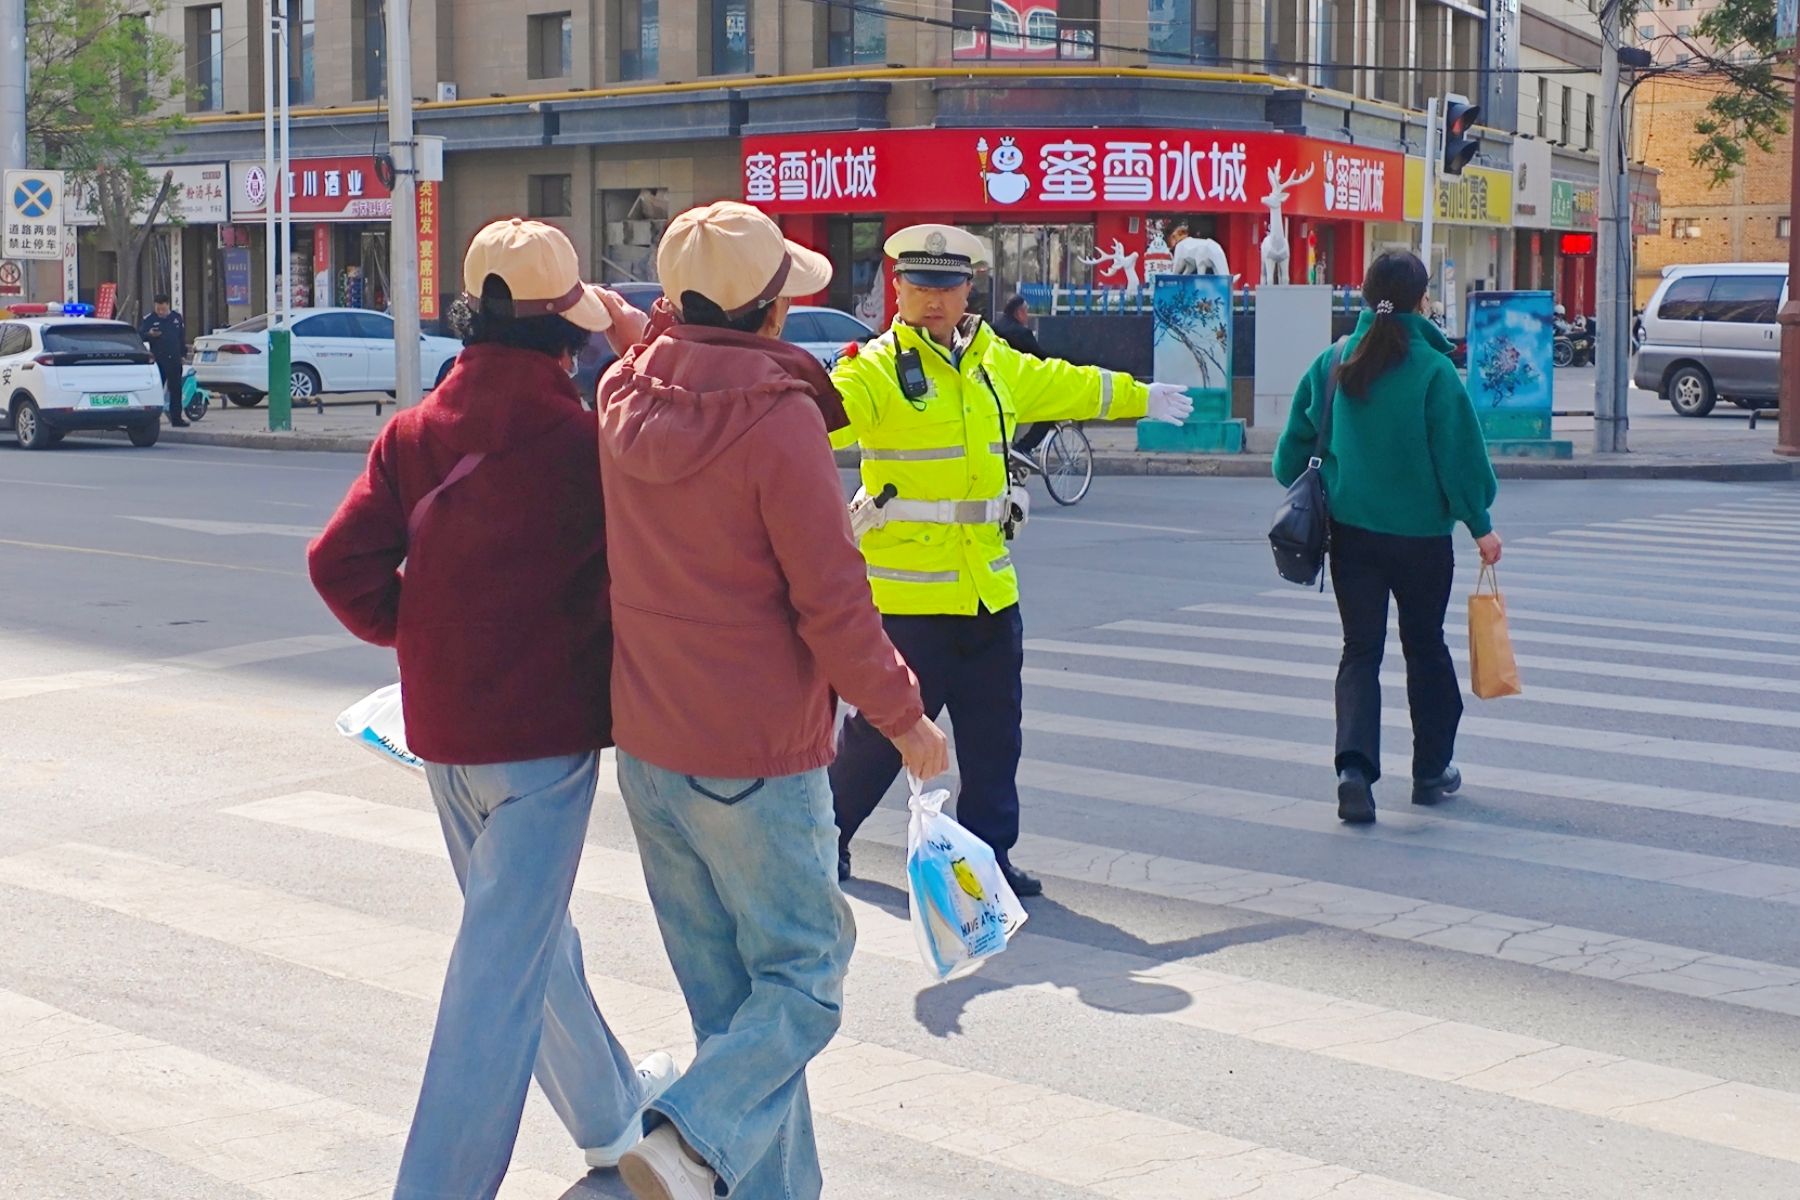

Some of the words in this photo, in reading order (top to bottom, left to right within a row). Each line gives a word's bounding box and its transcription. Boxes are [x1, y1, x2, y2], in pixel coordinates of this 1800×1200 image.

[746, 146, 877, 202] 蜜雪冰城
[1039, 139, 1248, 203] 蜜雪冰城
[1335, 154, 1384, 213] 蜜雪冰城
[8, 224, 57, 236] 道路两侧
[8, 238, 57, 250] 禁止停车
[419, 240, 434, 314] 宴席用酒
[2, 368, 13, 386] 安
